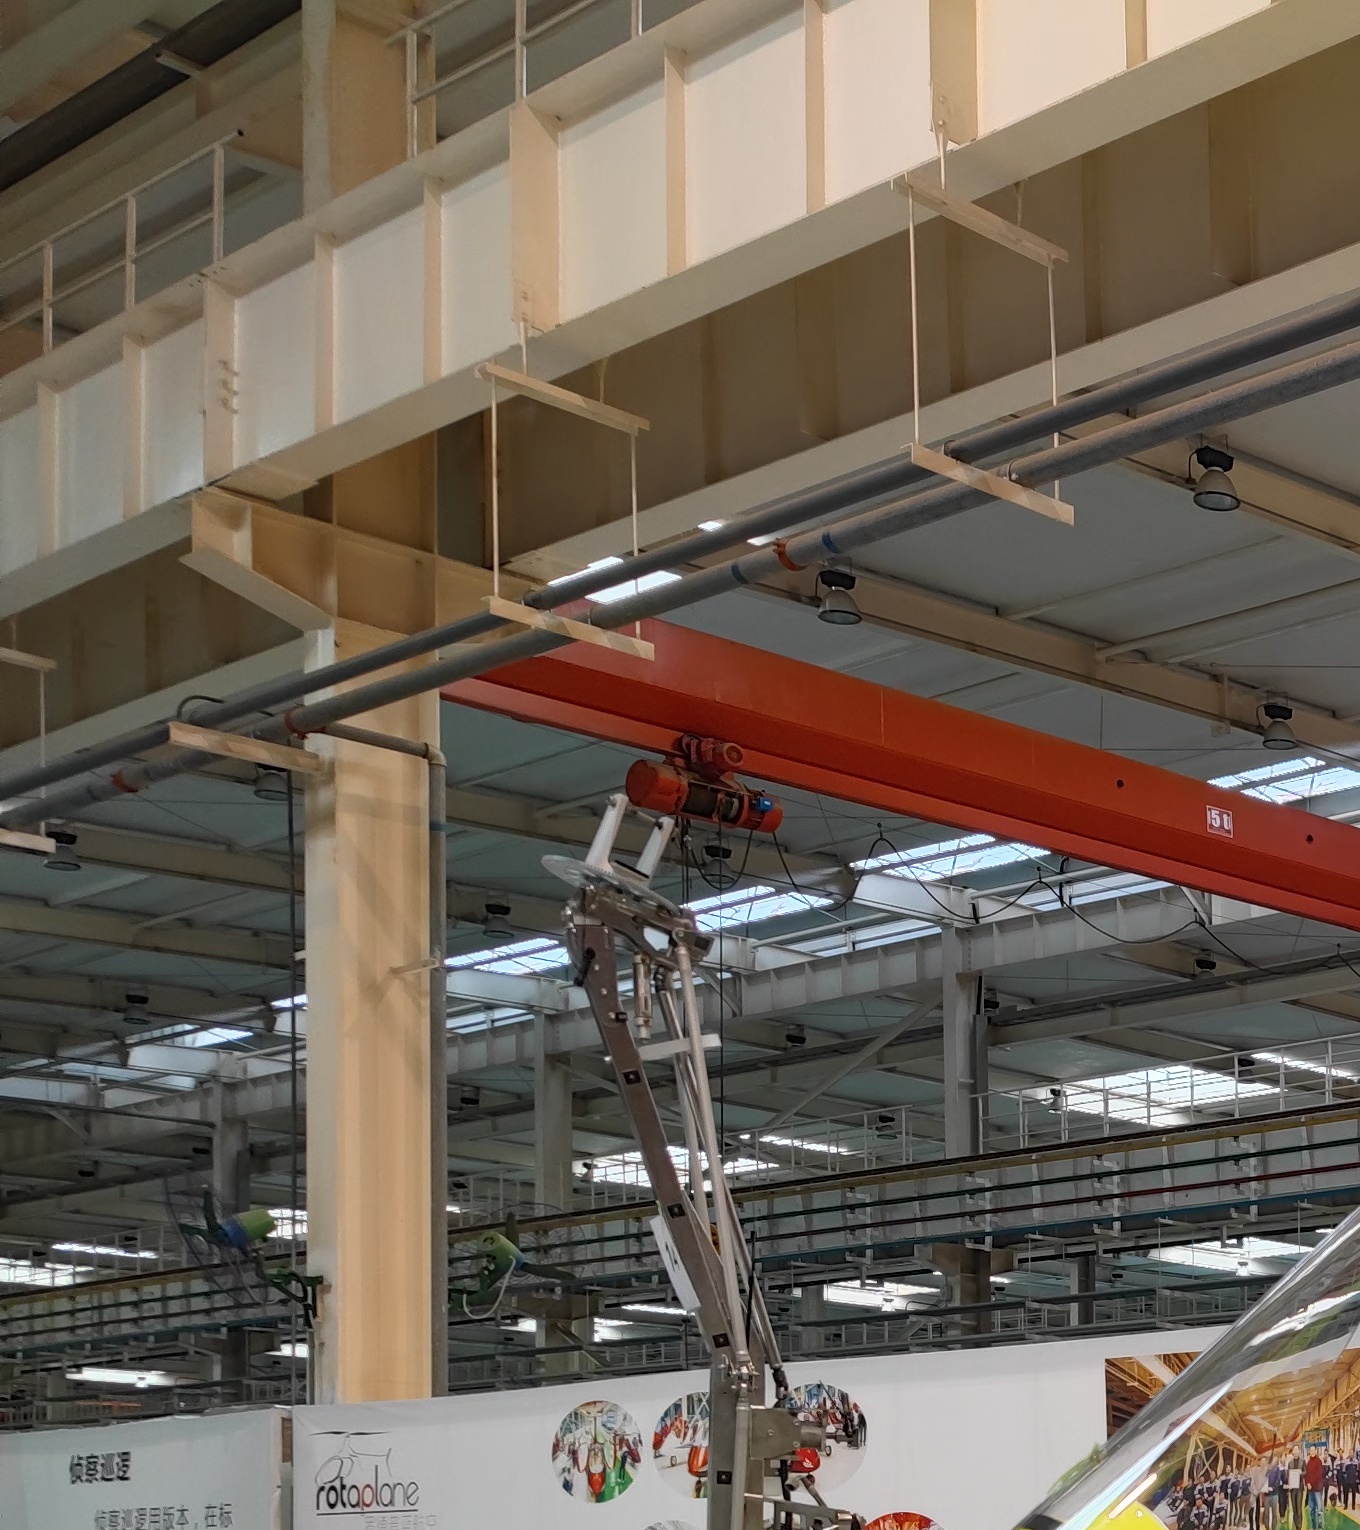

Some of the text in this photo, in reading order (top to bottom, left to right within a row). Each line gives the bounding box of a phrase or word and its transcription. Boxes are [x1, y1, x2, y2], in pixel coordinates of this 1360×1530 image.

[69, 1451, 131, 1485] 侦察巡逻
[316, 1464, 420, 1511] rotaplane
